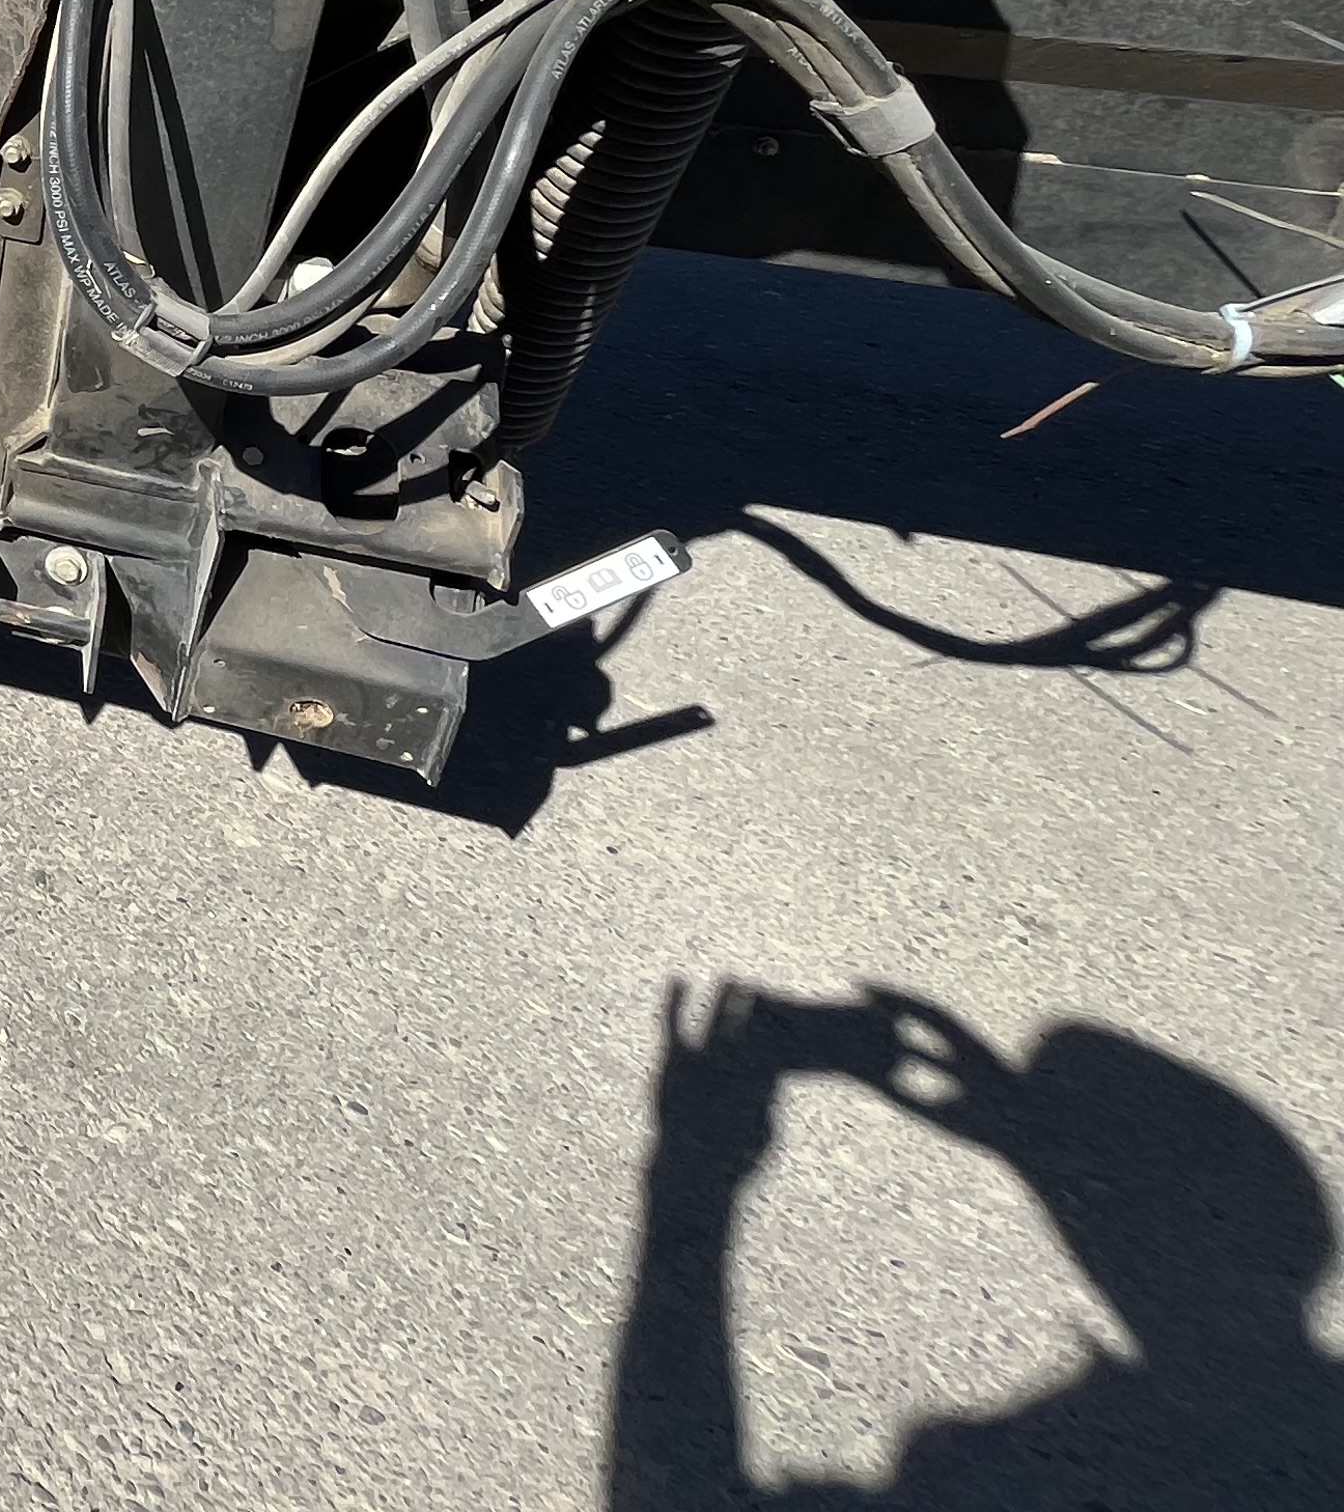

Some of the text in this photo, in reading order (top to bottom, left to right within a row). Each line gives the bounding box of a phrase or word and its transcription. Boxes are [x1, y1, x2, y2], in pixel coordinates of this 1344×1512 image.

[551, 39, 577, 80] ATLAS
[48, 141, 61, 174] INCH
[48, 177, 64, 208] 3000
[54, 210, 70, 233] PSI
[60, 234, 81, 265] MAX
[73, 264, 92, 288] WP
[103, 261, 138, 299] ATLAS
[86, 287, 120, 324] MADE
[234, 331, 269, 343] INCH
